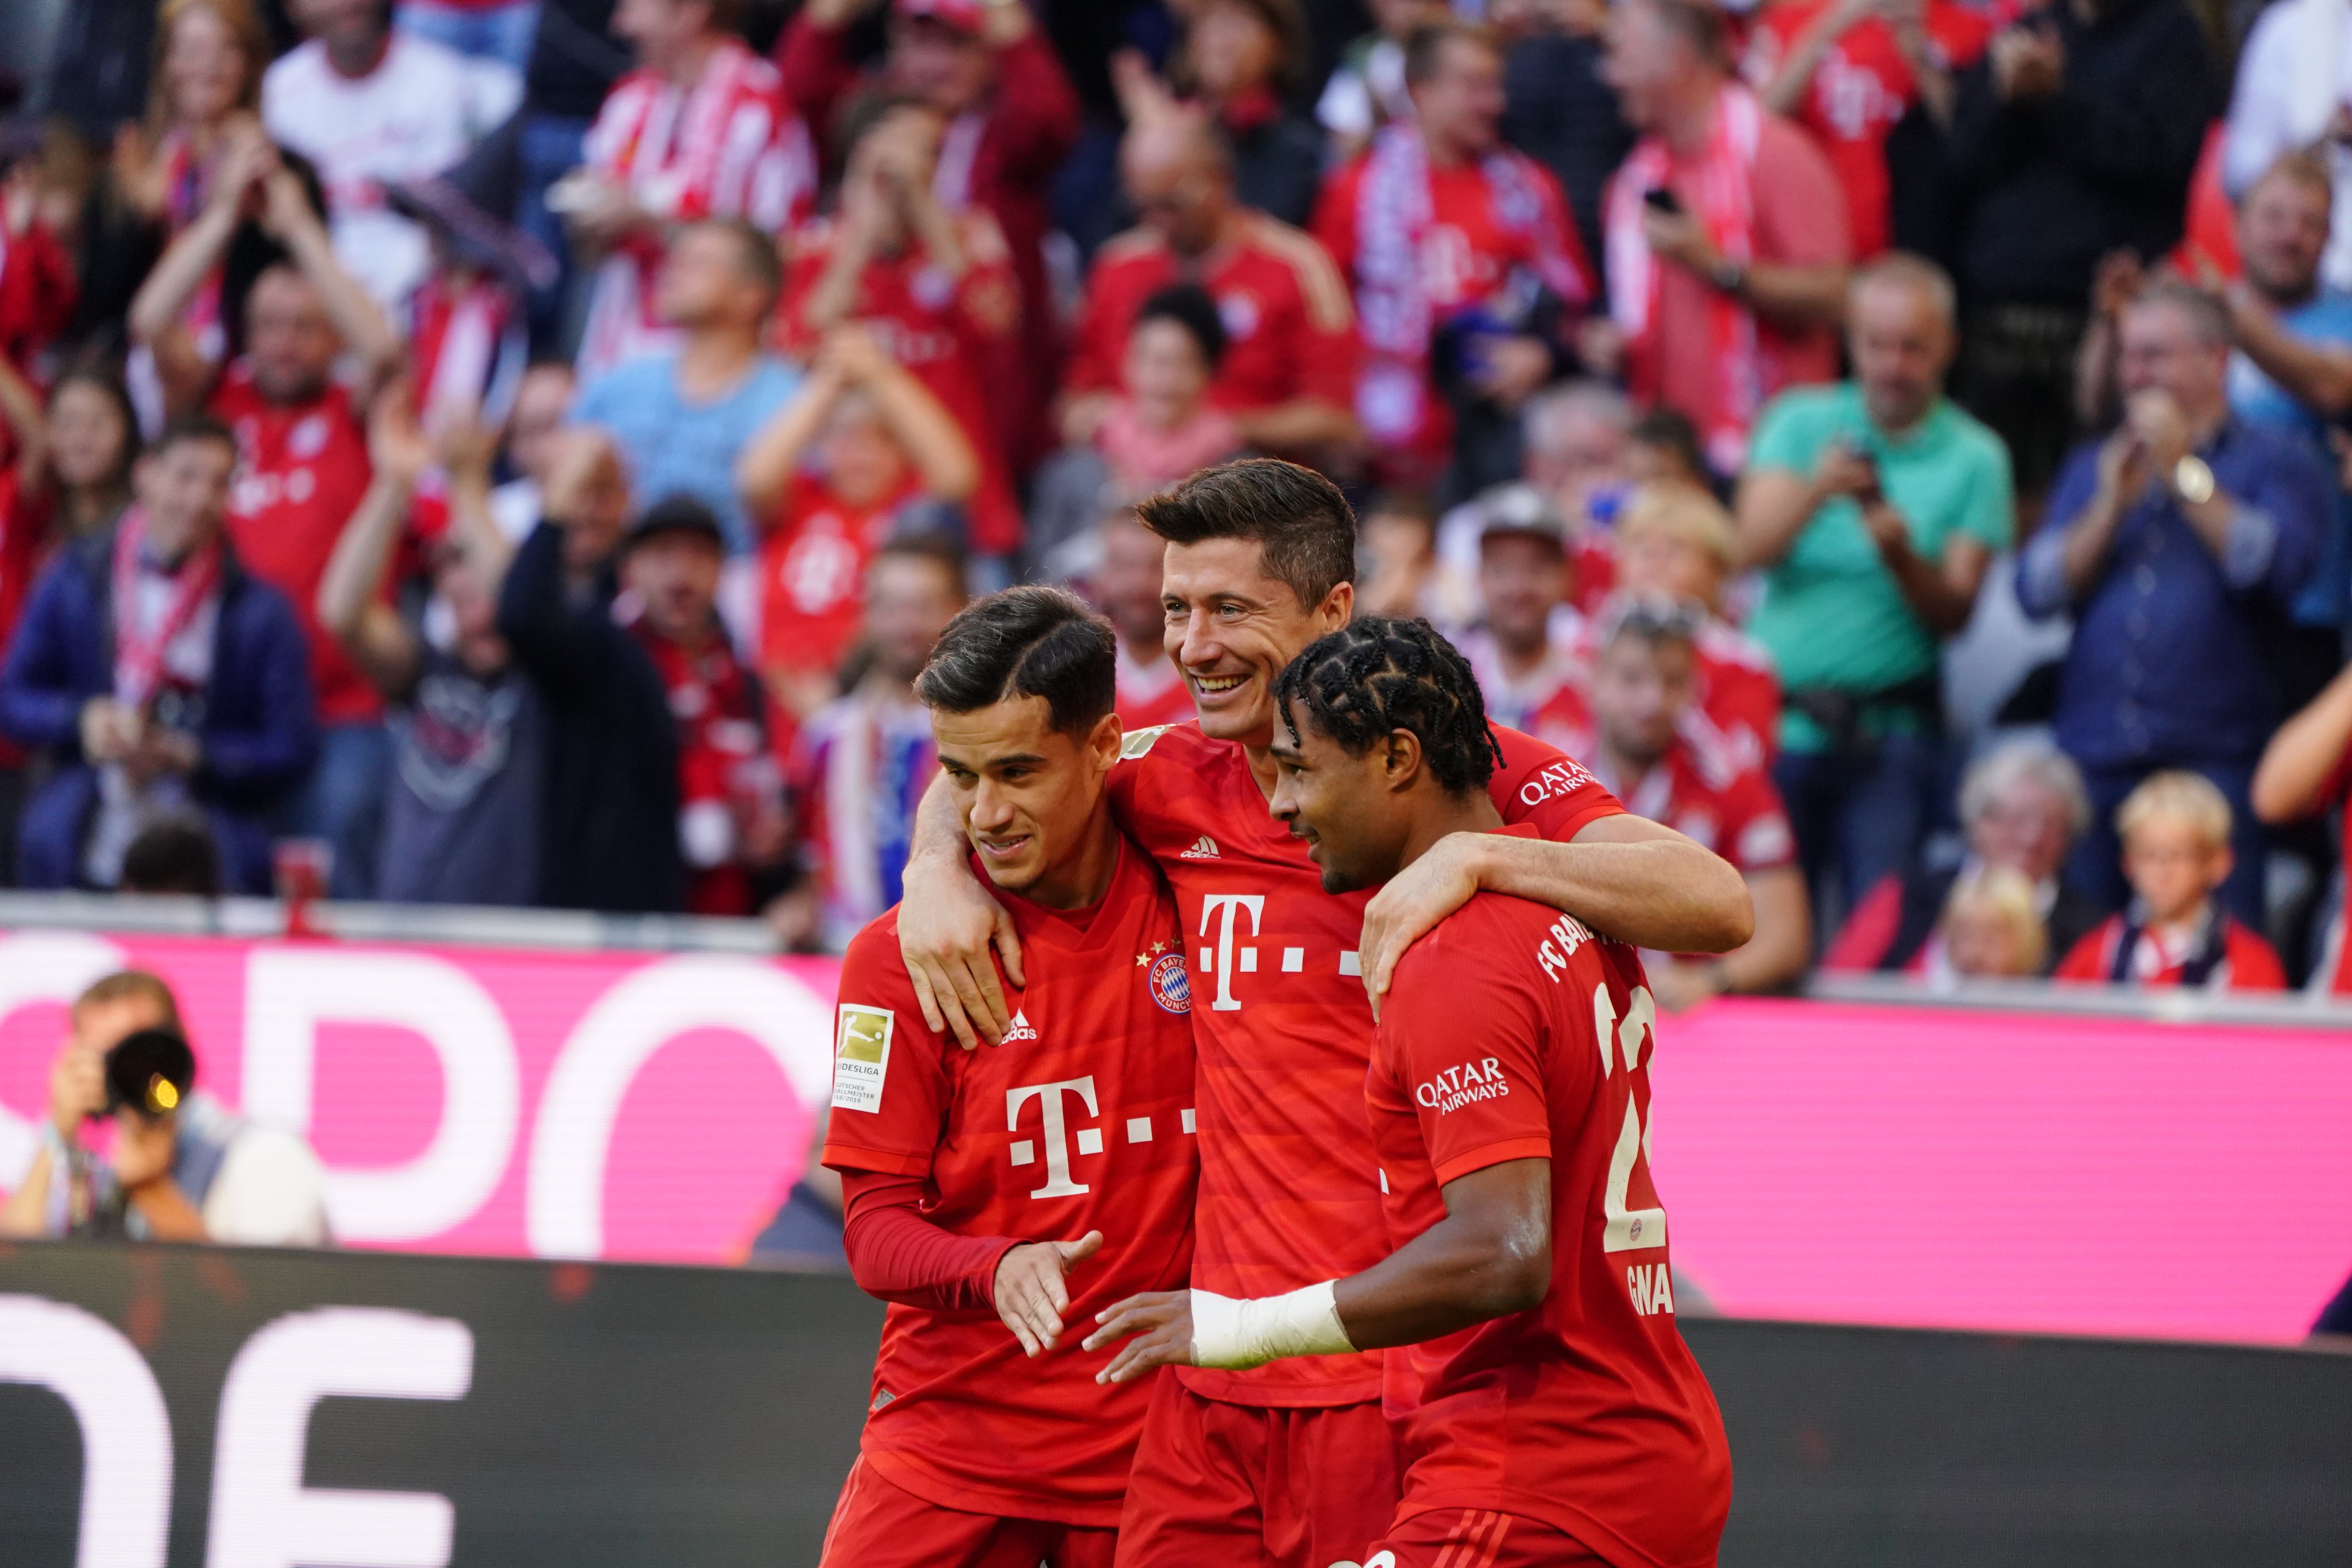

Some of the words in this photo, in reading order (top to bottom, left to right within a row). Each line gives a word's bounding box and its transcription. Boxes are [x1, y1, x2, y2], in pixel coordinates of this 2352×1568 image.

[1520, 761, 1592, 806] QATA
[1554, 773, 1602, 796] AIRWA
[1153, 969, 1163, 984] FC
[1160, 958, 1186, 970] BAYE
[1538, 939, 1567, 984] FC
[1158, 992, 1192, 1010] MÜNCH
[835, 1088, 875, 1099] ALLMEISTER
[836, 1082, 865, 1091] UTSCHER
[1417, 1056, 1504, 1108] QATAR
[834, 1095, 861, 1104] 18/2019
[1441, 1080, 1509, 1116] AIRWAYS
